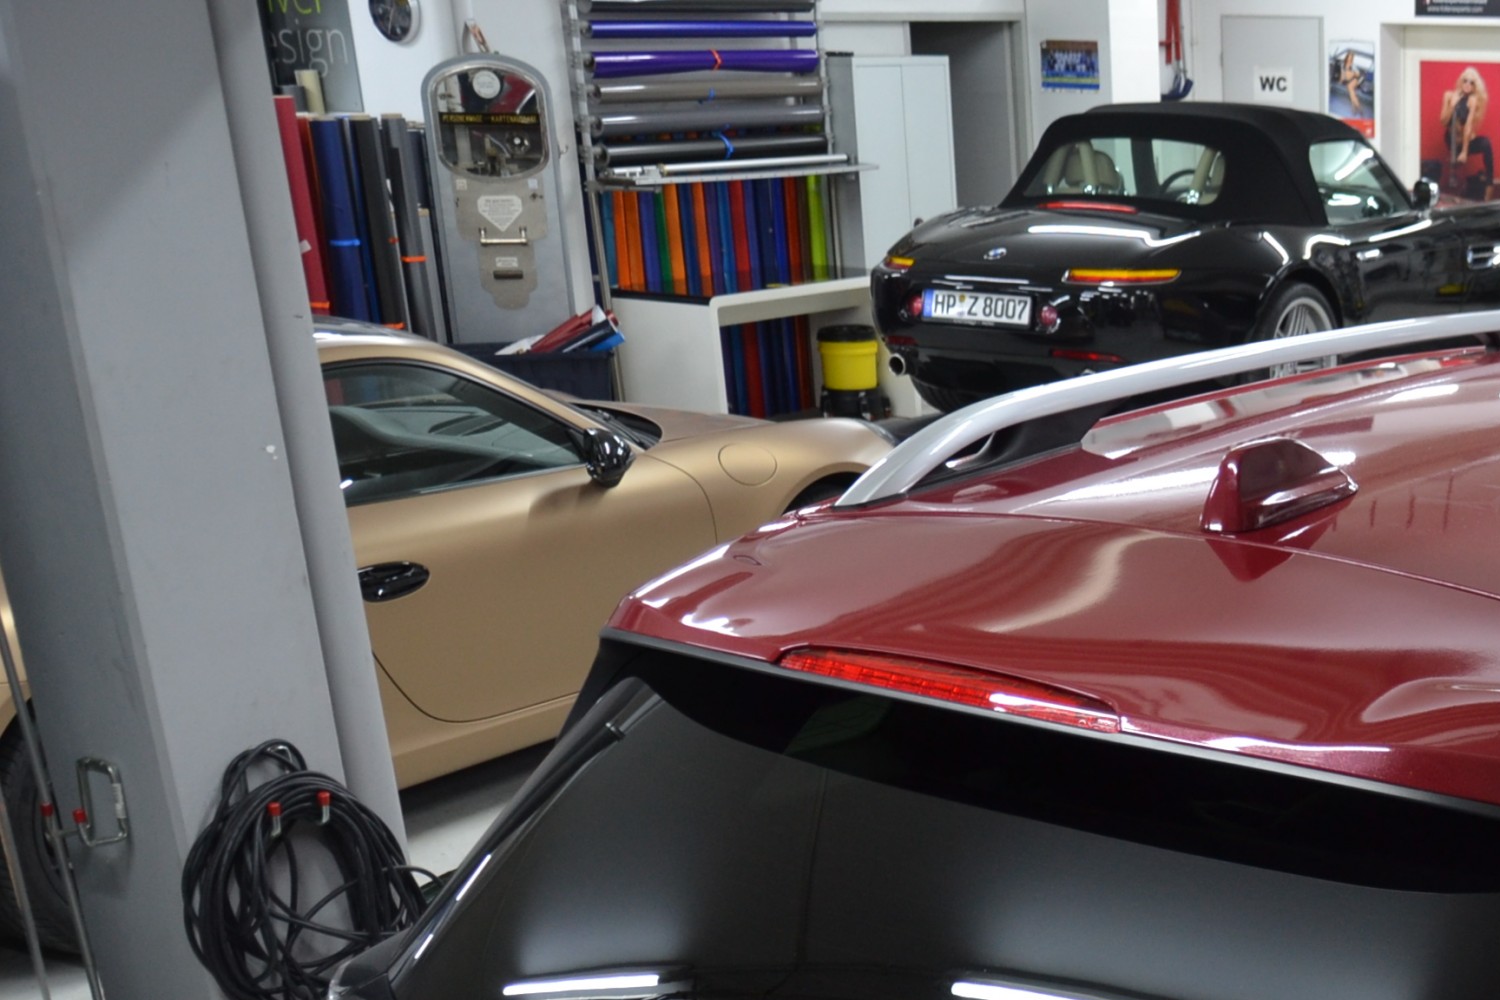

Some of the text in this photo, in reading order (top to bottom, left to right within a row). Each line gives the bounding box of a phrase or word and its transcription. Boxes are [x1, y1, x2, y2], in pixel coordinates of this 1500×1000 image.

[1259, 75, 1288, 92] WC
[934, 292, 1029, 320] HP Z 8007
